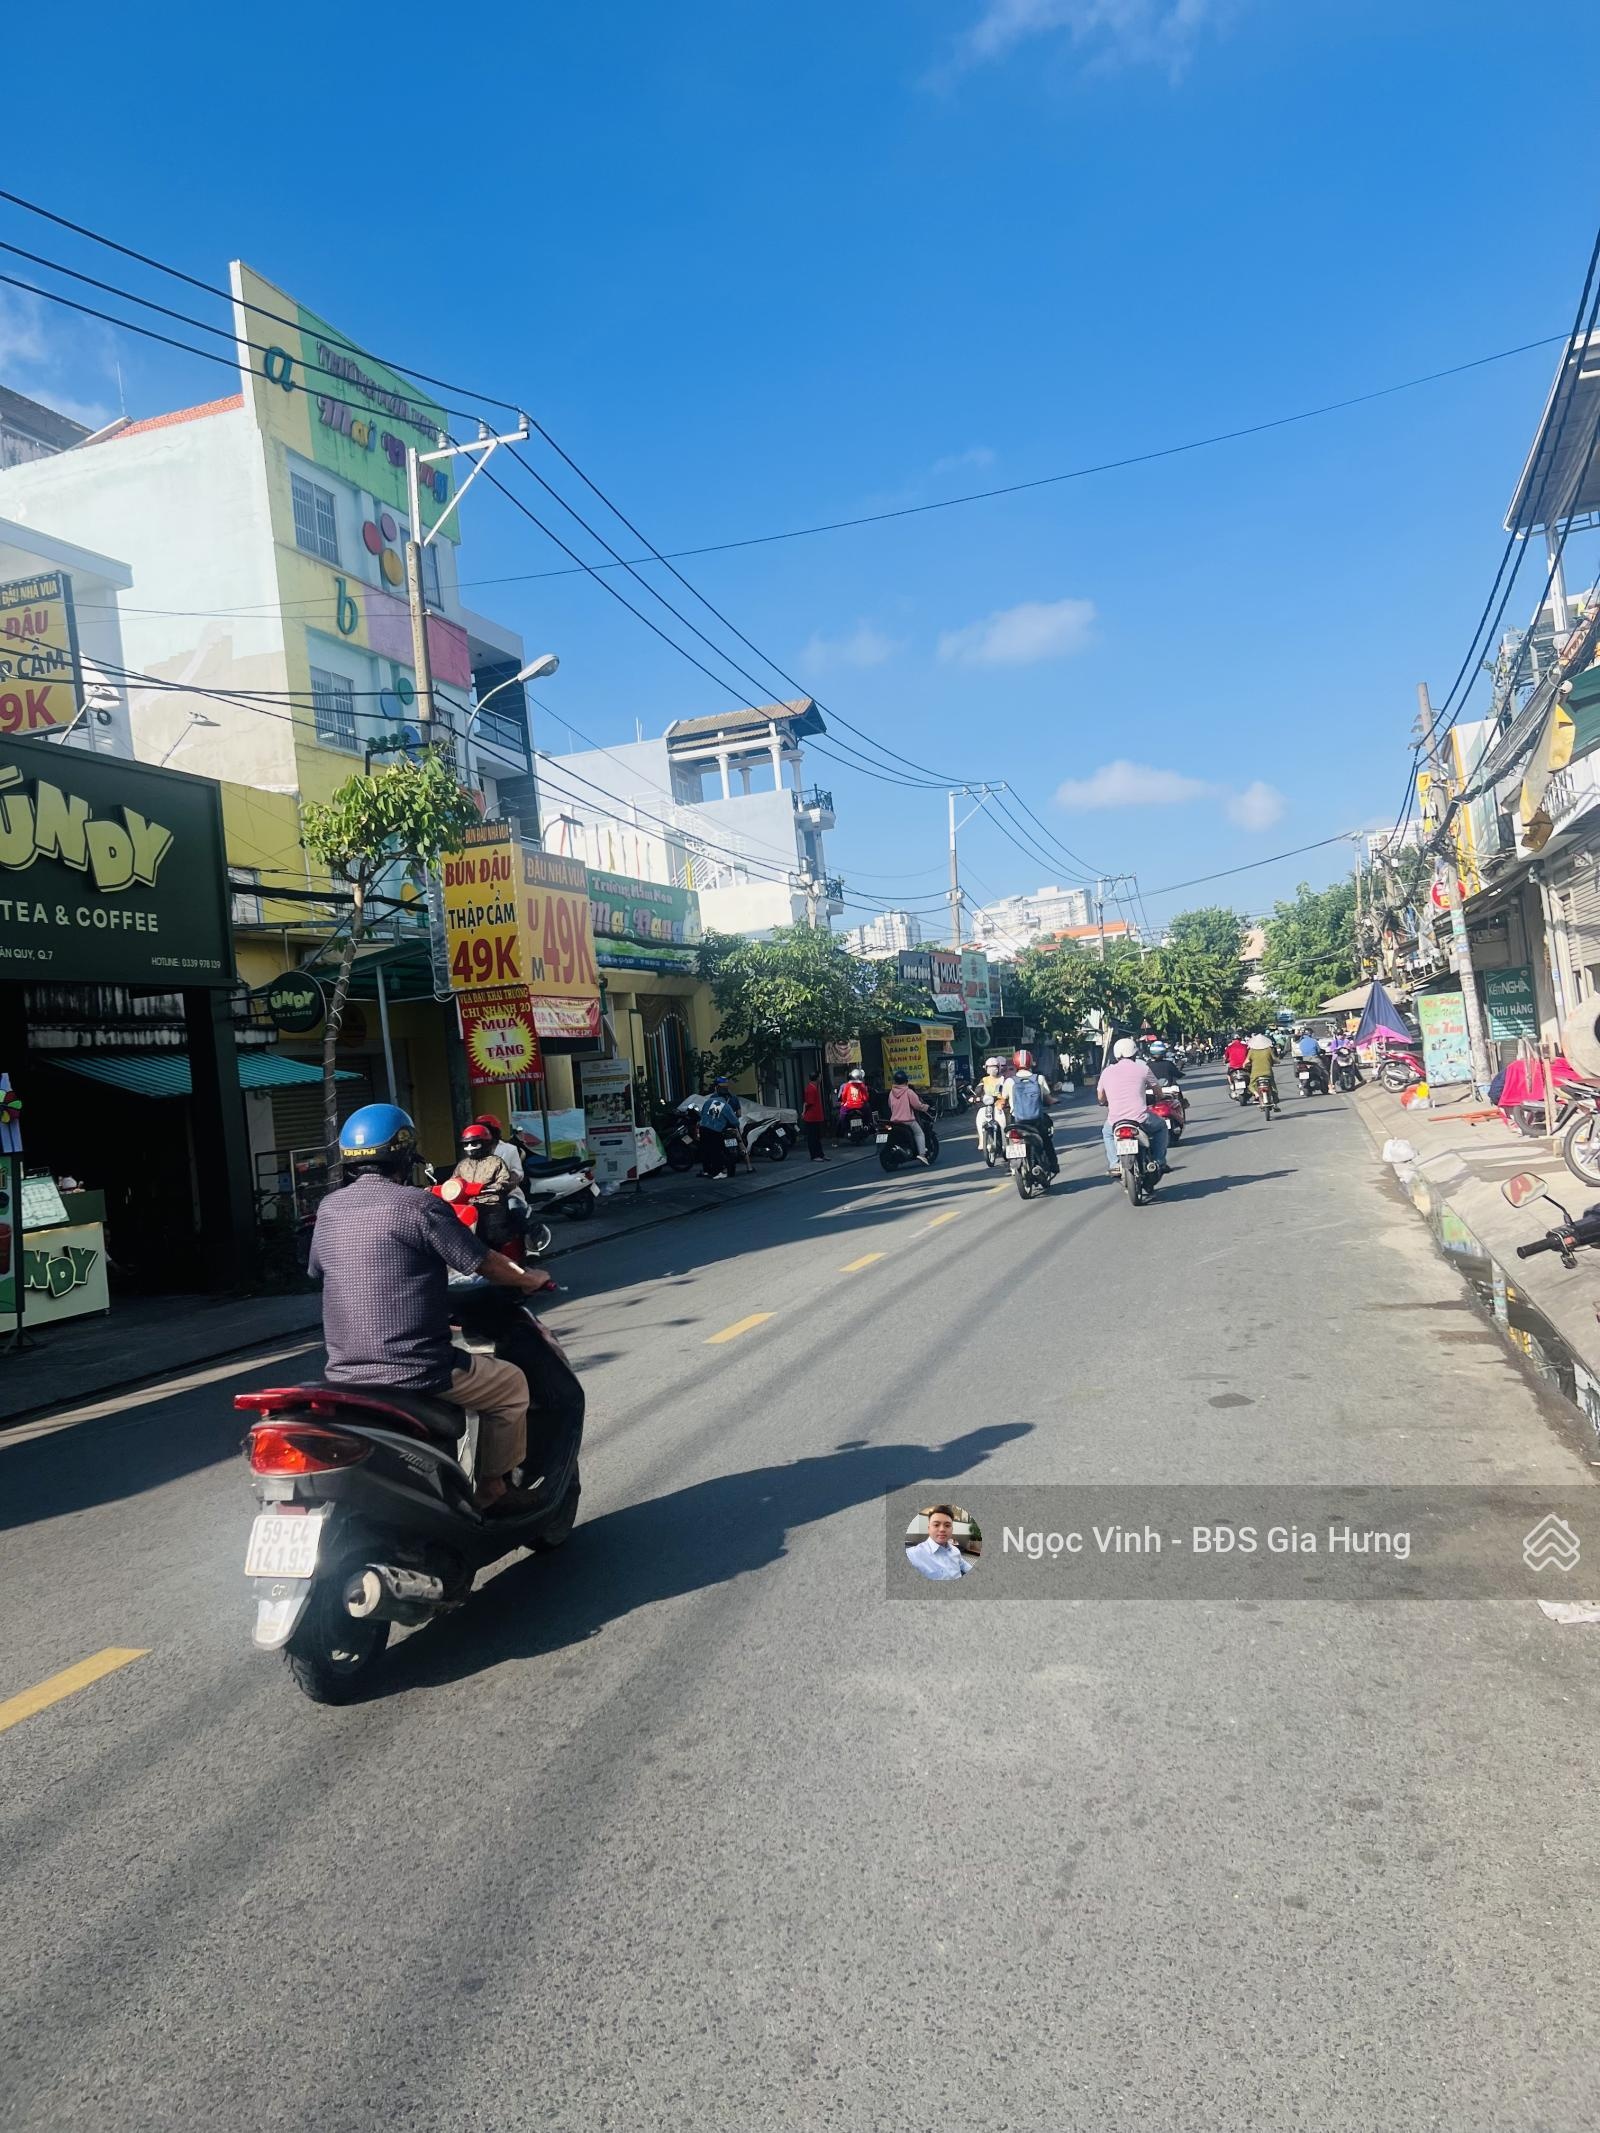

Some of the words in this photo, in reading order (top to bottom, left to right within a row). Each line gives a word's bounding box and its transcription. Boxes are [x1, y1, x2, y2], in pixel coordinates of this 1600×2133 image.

[6, 606, 49, 643] ĐẬU
[335, 577, 358, 635] b
[445, 852, 475, 887] BÚN
[479, 849, 511, 890] ĐẬU
[527, 855, 547, 884] ĐẬU
[548, 858, 566, 887] NHÀ
[567, 865, 586, 889] VUA
[0, 900, 48, 924] TEA
[56, 905, 71, 926] &
[76, 907, 159, 933] COFFEE
[448, 900, 484, 934] THẬP
[486, 890, 516, 926] CẨM
[543, 895, 597, 985] 49K
[453, 935, 521, 983] 49K
[462, 1007, 481, 1019] CHI
[519, 1002, 531, 1013] 20
[481, 1017, 519, 1031] MUA
[1491, 1005, 1508, 1017] THU
